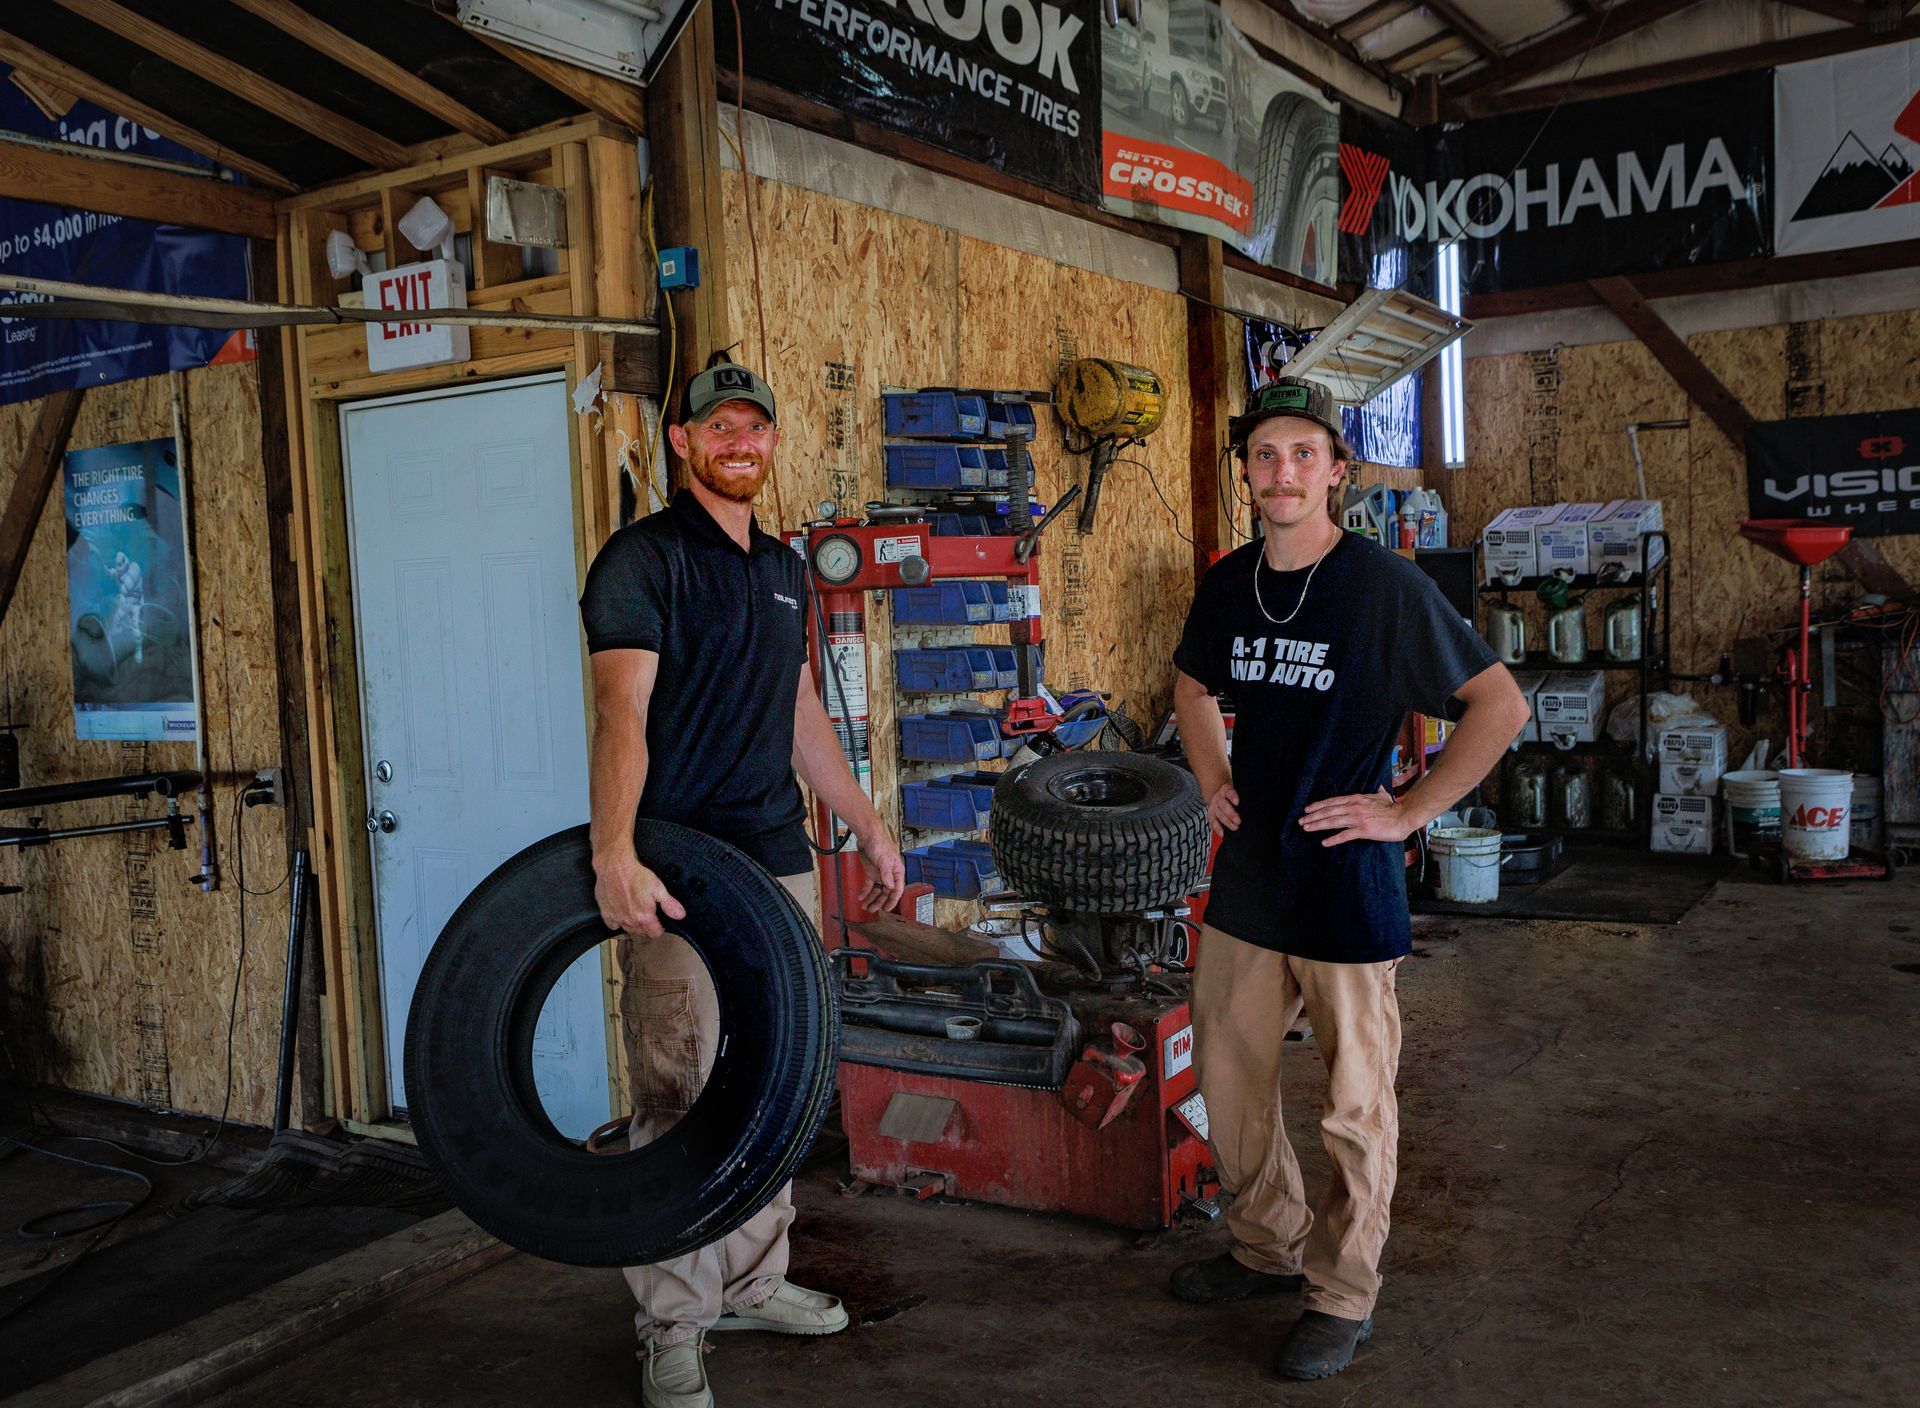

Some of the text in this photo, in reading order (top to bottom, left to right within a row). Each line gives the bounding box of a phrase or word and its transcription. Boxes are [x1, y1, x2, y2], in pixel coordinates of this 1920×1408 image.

[1017, 82, 1081, 138] TIRES
[1116, 148, 1175, 170] NITTO
[1109, 161, 1242, 218] CROSSTEK
[1389, 136, 1748, 243] YOKOHAMA
[14, 234, 30, 254] to
[34, 213, 82, 250] $4,000
[84, 211, 97, 234] in
[379, 271, 432, 340] EXIT
[5, 325, 37, 344] Leasing
[72, 464, 144, 489] THE RIGHT TIRE
[73, 488, 119, 508] CHANGES
[74, 505, 137, 528] EVERYTHING.
[835, 636, 864, 645] DANGER
[1232, 636, 1330, 666] A-1 TIRE
[1268, 662, 1336, 692] AUTO
[1789, 804, 1844, 829] ACE
[1173, 1033, 1191, 1060] RIM
